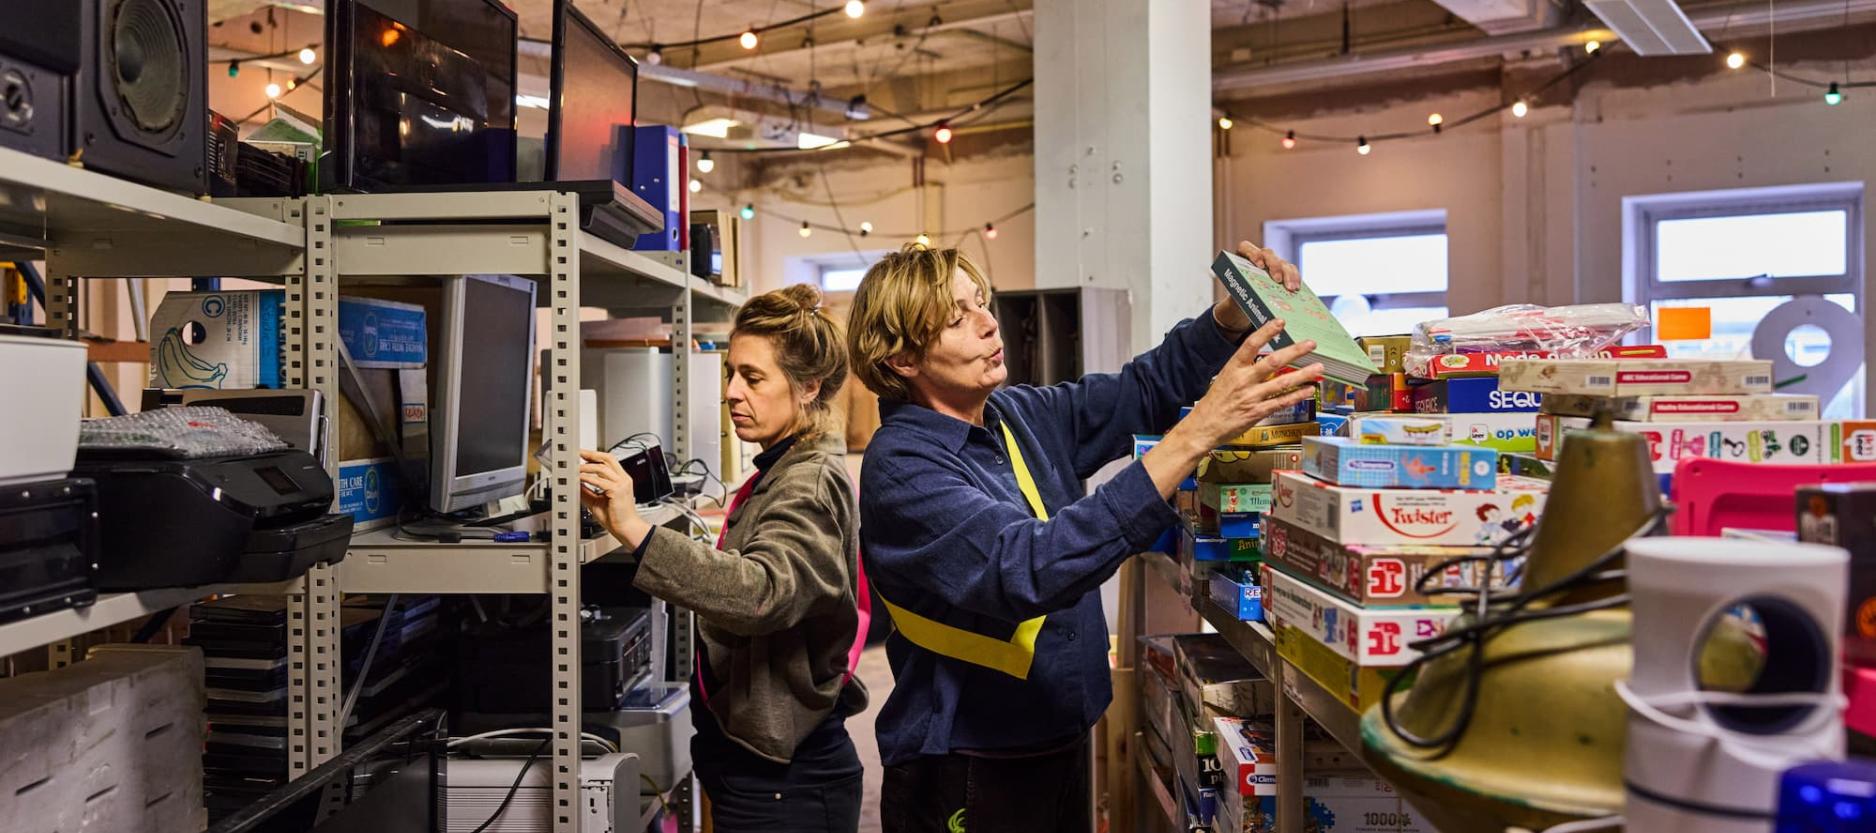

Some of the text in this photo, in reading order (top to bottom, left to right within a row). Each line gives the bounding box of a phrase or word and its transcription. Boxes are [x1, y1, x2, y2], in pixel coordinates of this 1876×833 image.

[1224, 268, 1249, 300] Magnetic
[204, 299, 223, 314] C
[1496, 429, 1515, 440] op
[1391, 508, 1452, 524] Twister
[1363, 812, 1397, 826] 1000
